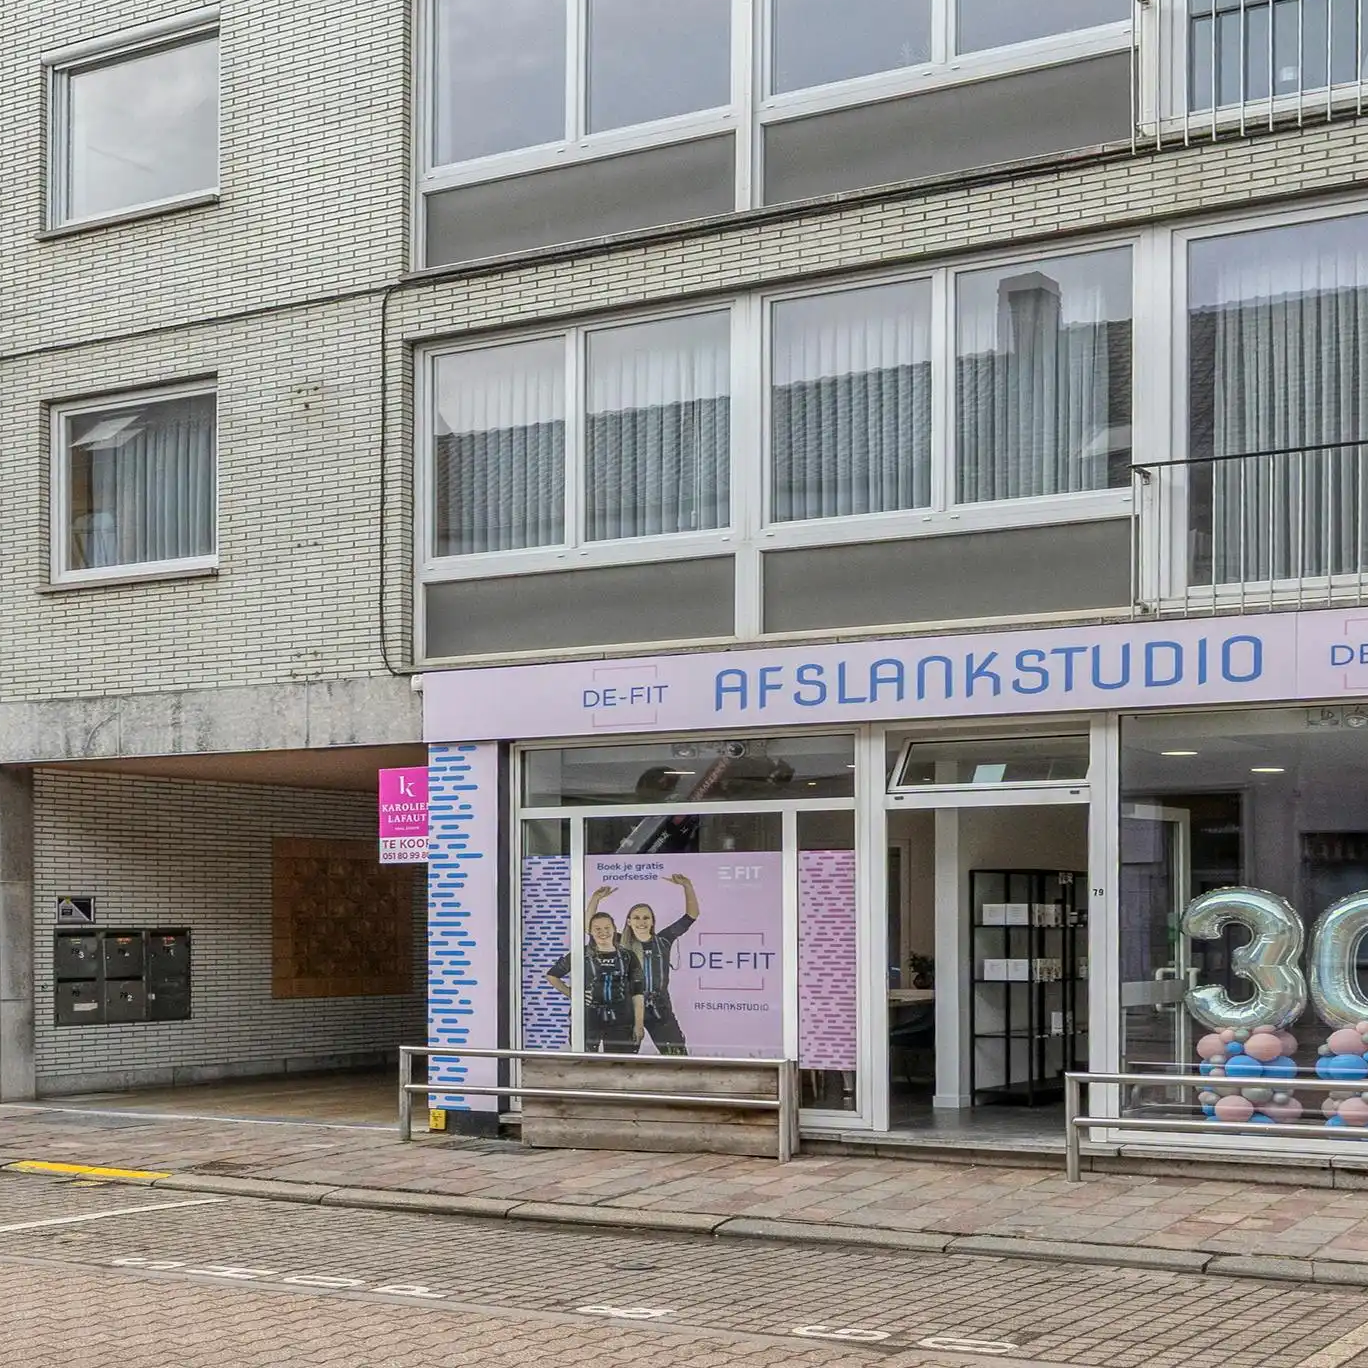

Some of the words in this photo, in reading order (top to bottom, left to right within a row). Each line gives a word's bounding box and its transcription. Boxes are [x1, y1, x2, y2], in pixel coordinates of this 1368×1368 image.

[715, 635, 1263, 712] AFSLANKSTUDIO
[583, 685, 669, 708] DE-FIT
[388, 814, 427, 823] LAFAUT
[383, 840, 396, 849] TE
[383, 852, 396, 860] 051
[410, 851, 420, 859] 99
[597, 862, 621, 870] Boek
[624, 862, 632, 871] je
[635, 862, 664, 871] gratis
[603, 873, 658, 882] proefsessie
[1092, 888, 1104, 896] 79
[690, 952, 776, 969] DE-FIT
[694, 1002, 769, 1011] AFSLANKSTUDIO
